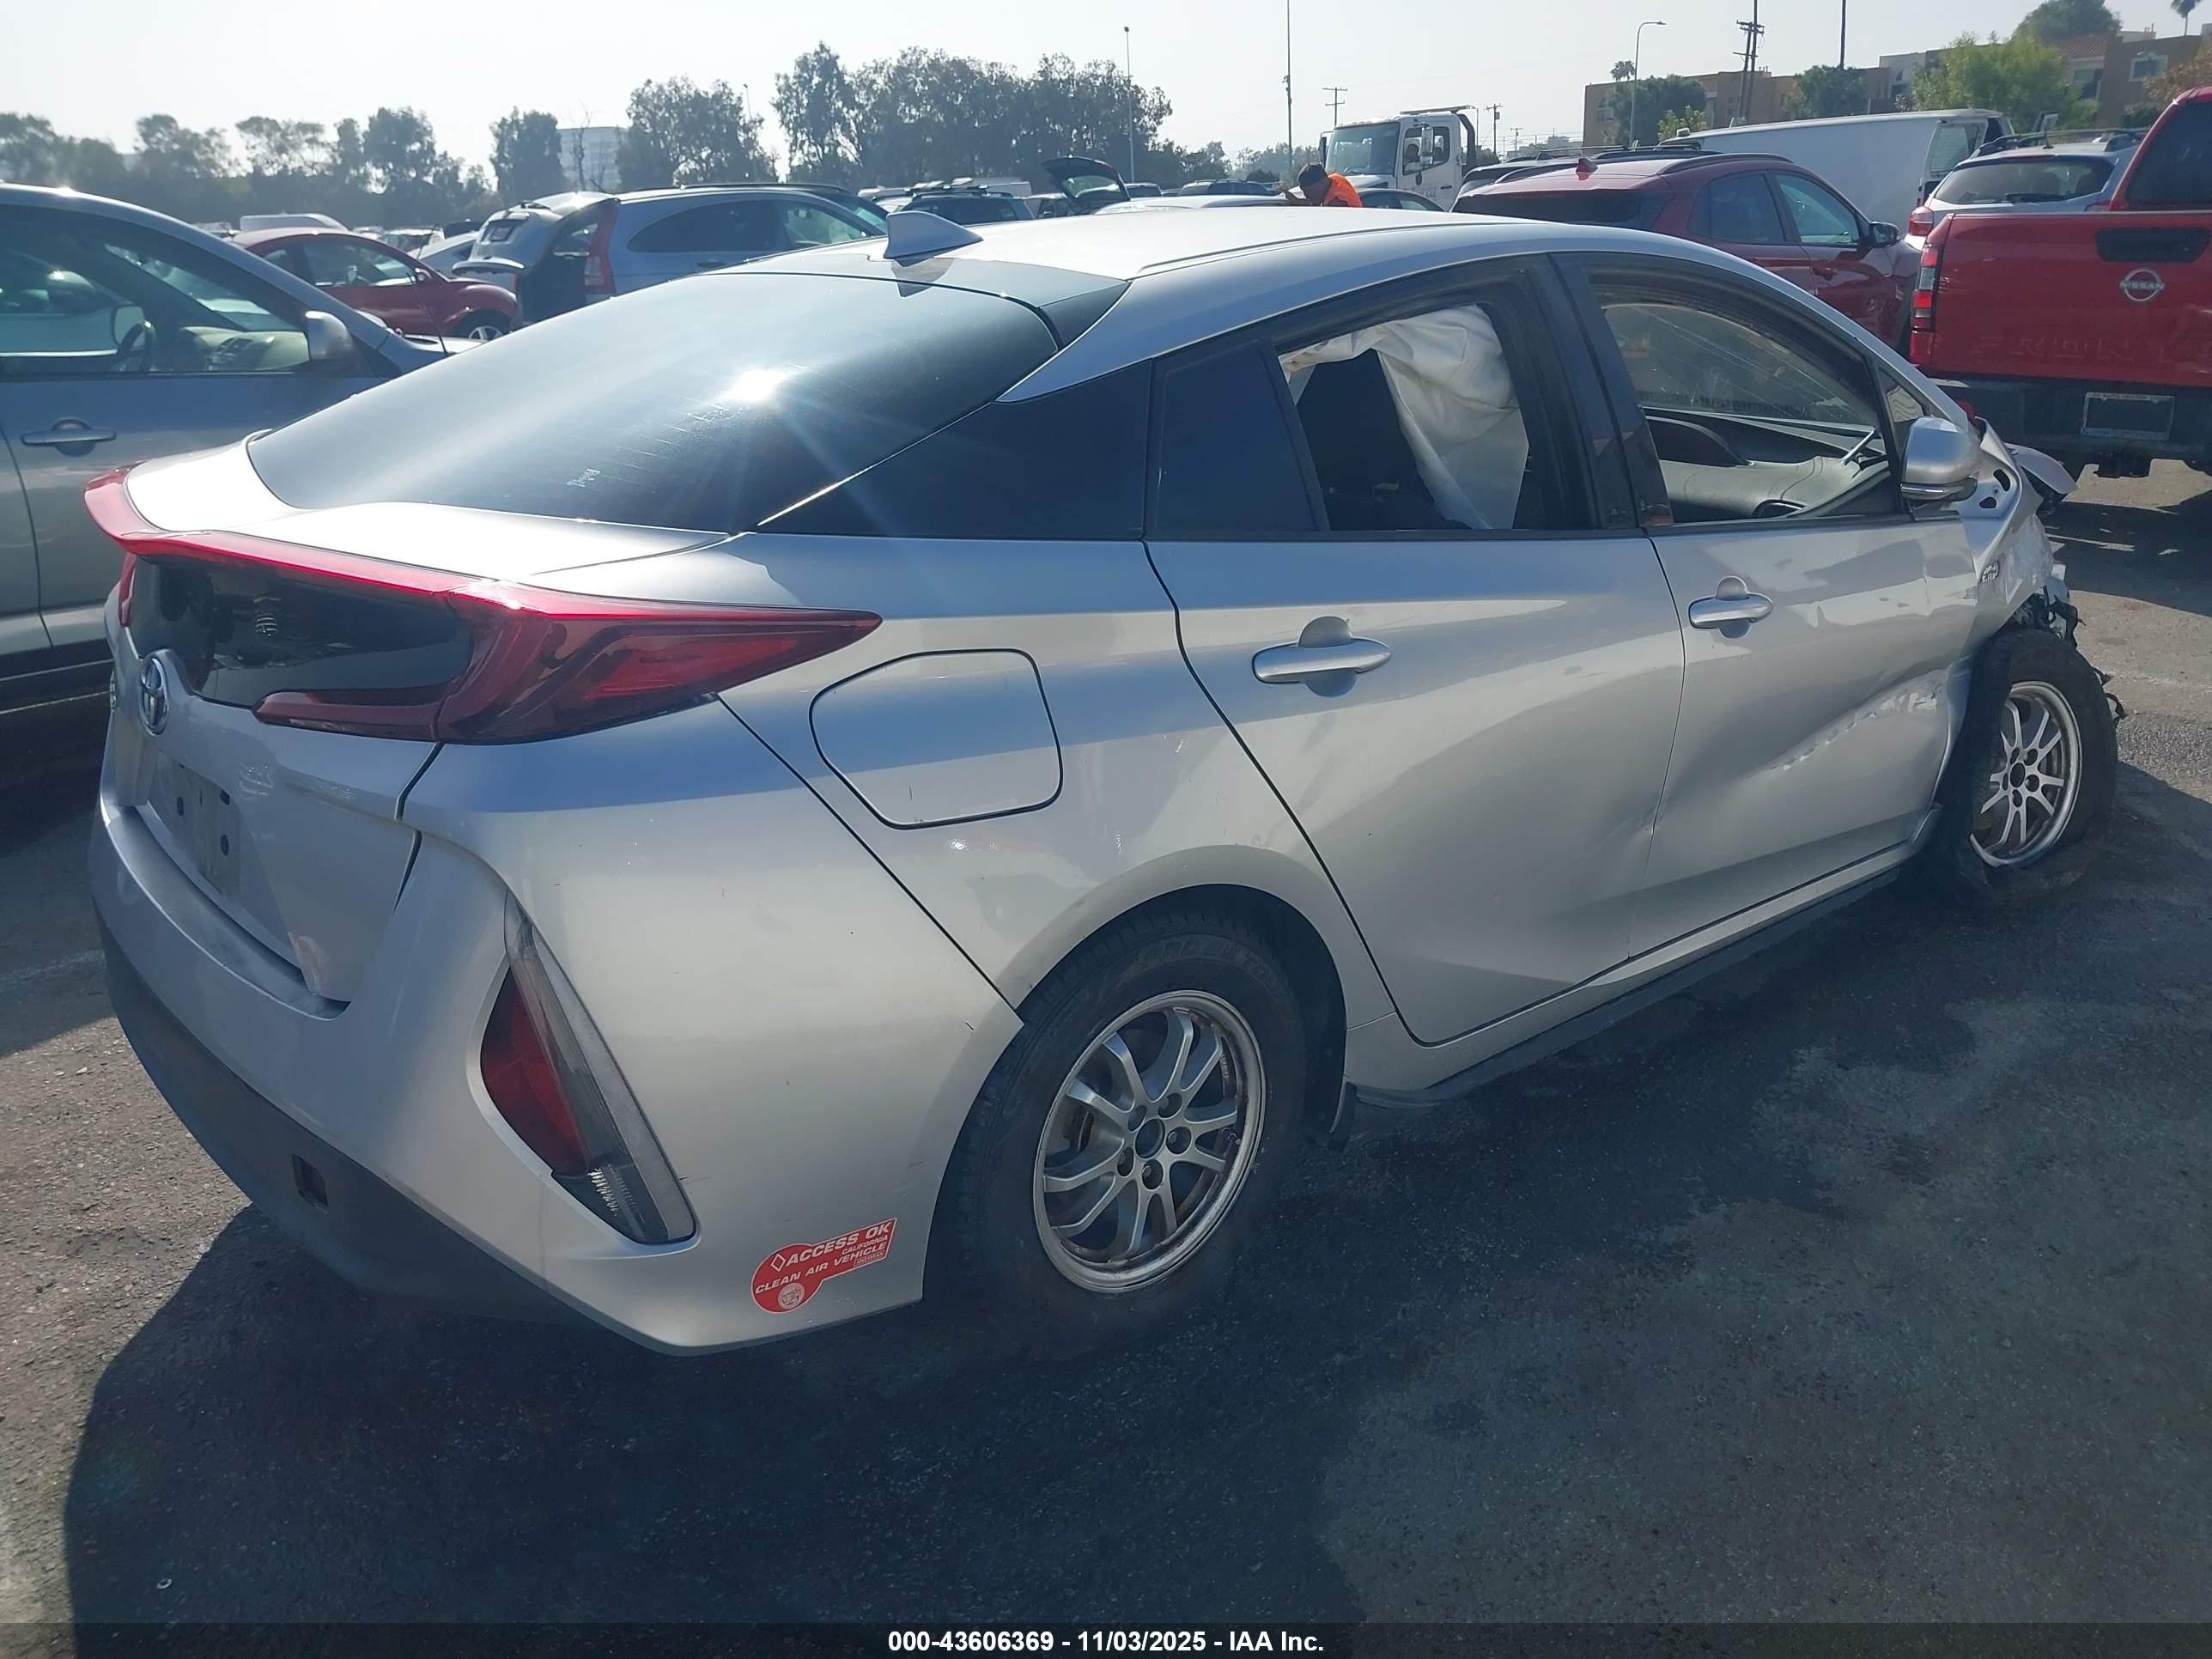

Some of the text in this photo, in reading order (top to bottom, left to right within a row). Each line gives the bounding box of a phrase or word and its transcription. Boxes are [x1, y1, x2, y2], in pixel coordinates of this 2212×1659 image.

[2119, 280, 2165, 290] NISSAN
[785, 1232, 860, 1267] ACCESS
[865, 1221, 893, 1239] OK
[842, 1234, 888, 1255] CALIFORNIA
[755, 1272, 801, 1294] CLEAN
[805, 1261, 829, 1277] AIR
[834, 1242, 888, 1267] VEHICLE
